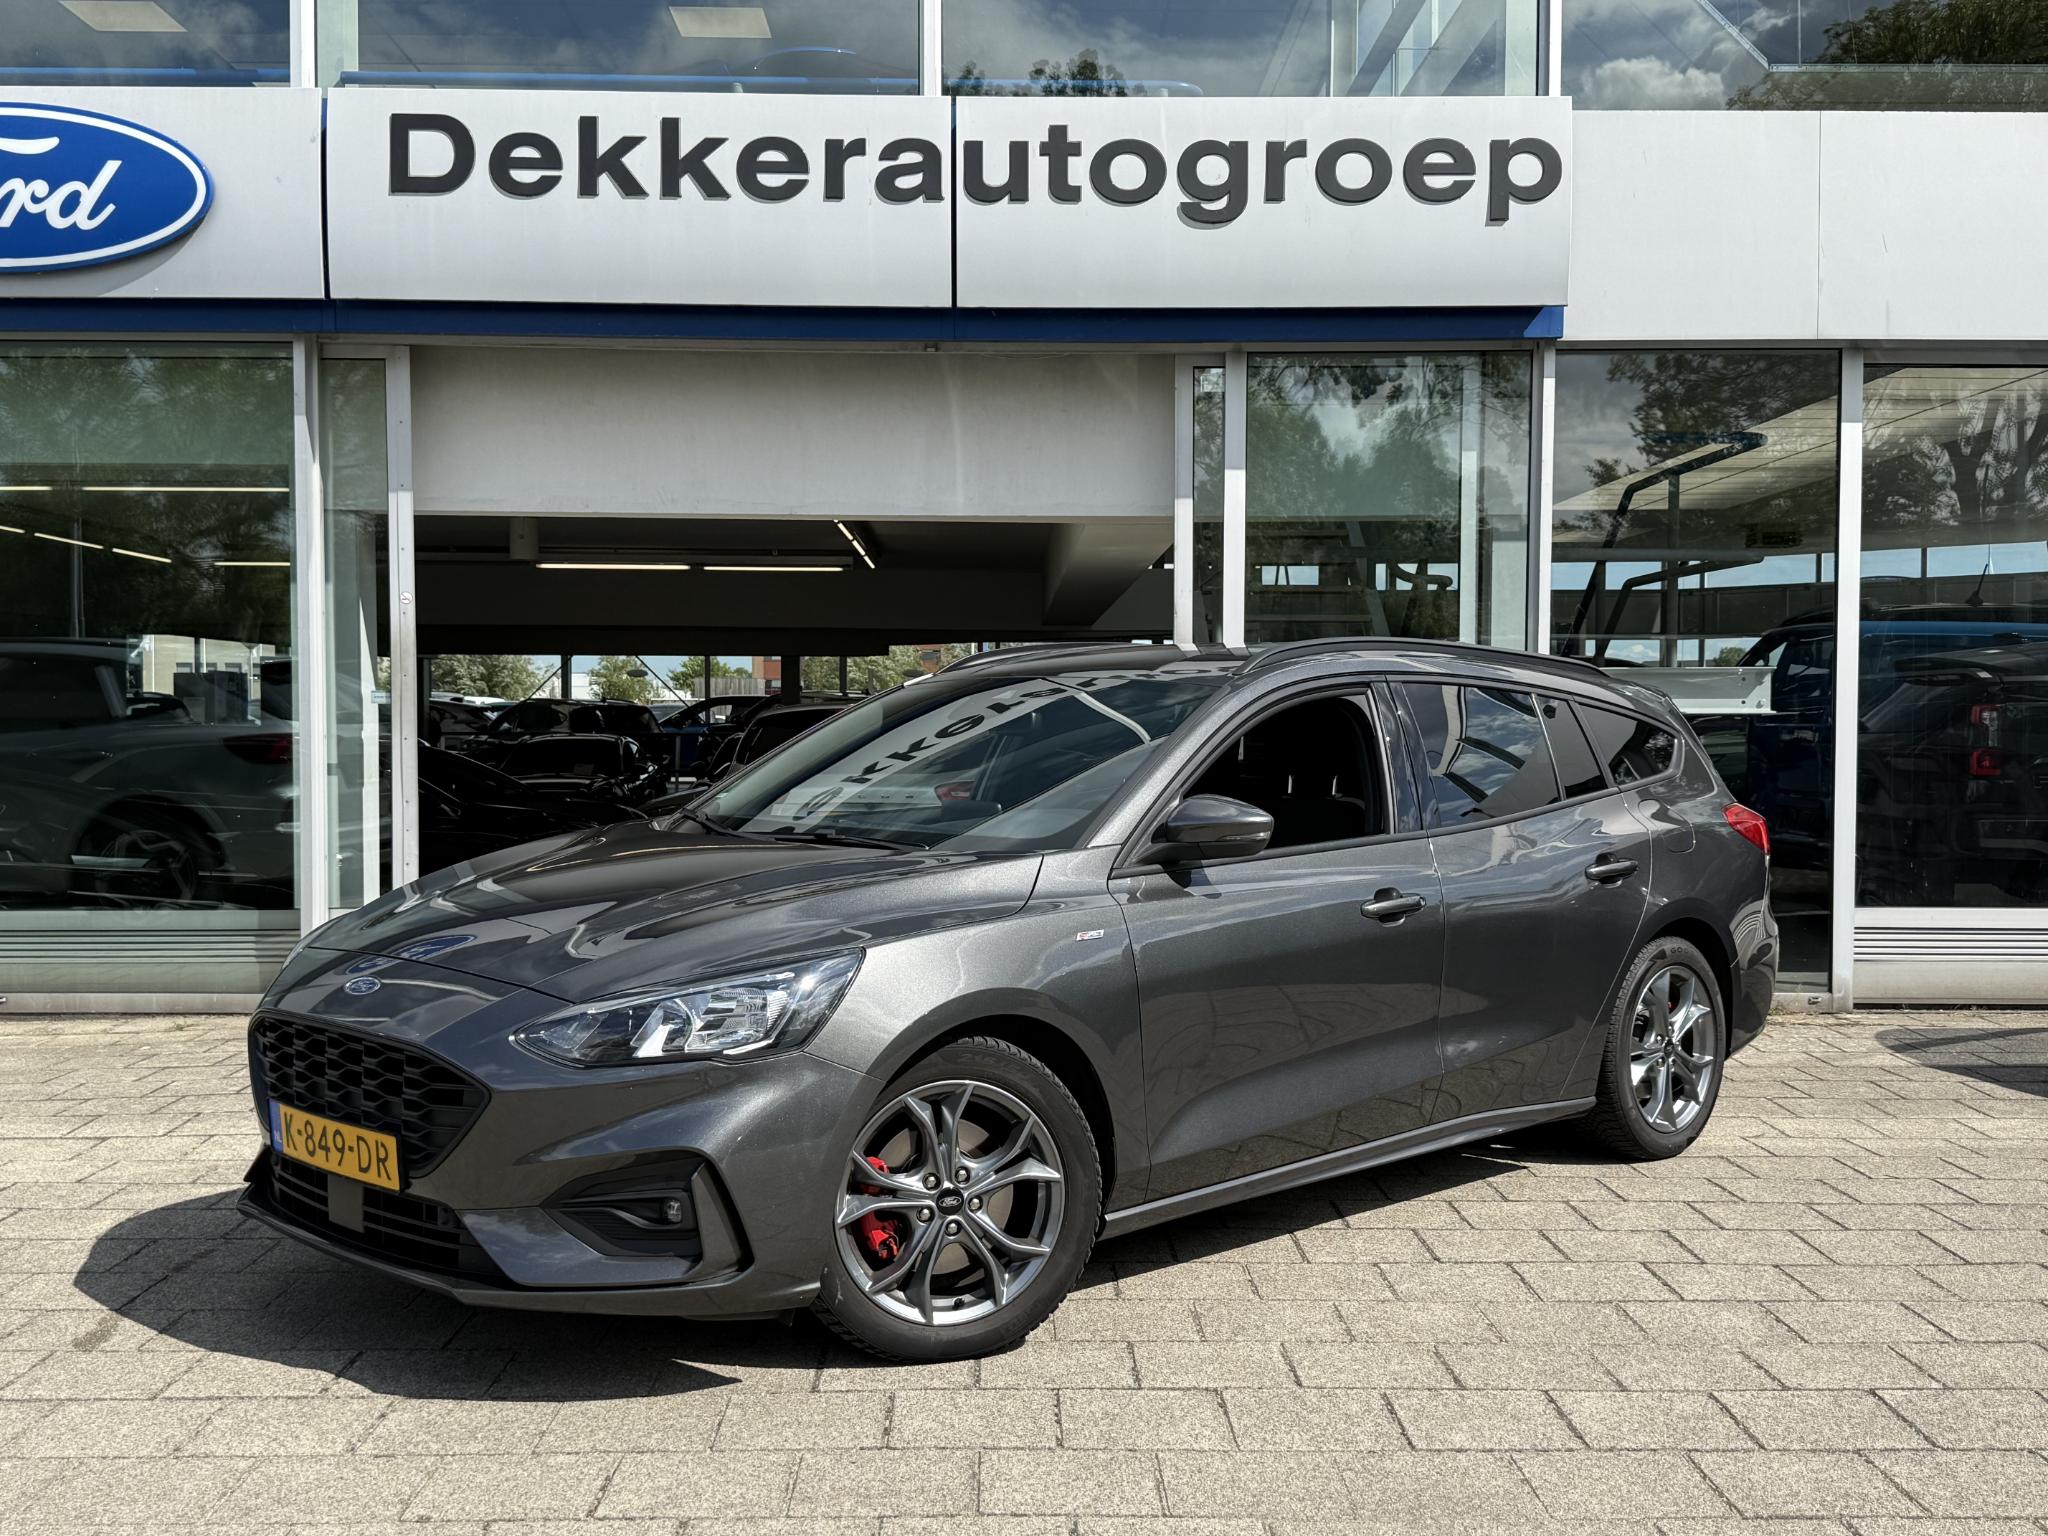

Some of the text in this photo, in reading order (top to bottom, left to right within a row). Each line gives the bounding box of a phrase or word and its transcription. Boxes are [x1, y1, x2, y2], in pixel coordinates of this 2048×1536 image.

[0, 136, 122, 230] rd
[388, 113, 1563, 224] Dekkerautogroep
[284, 1112, 391, 1180] K-849-DR
